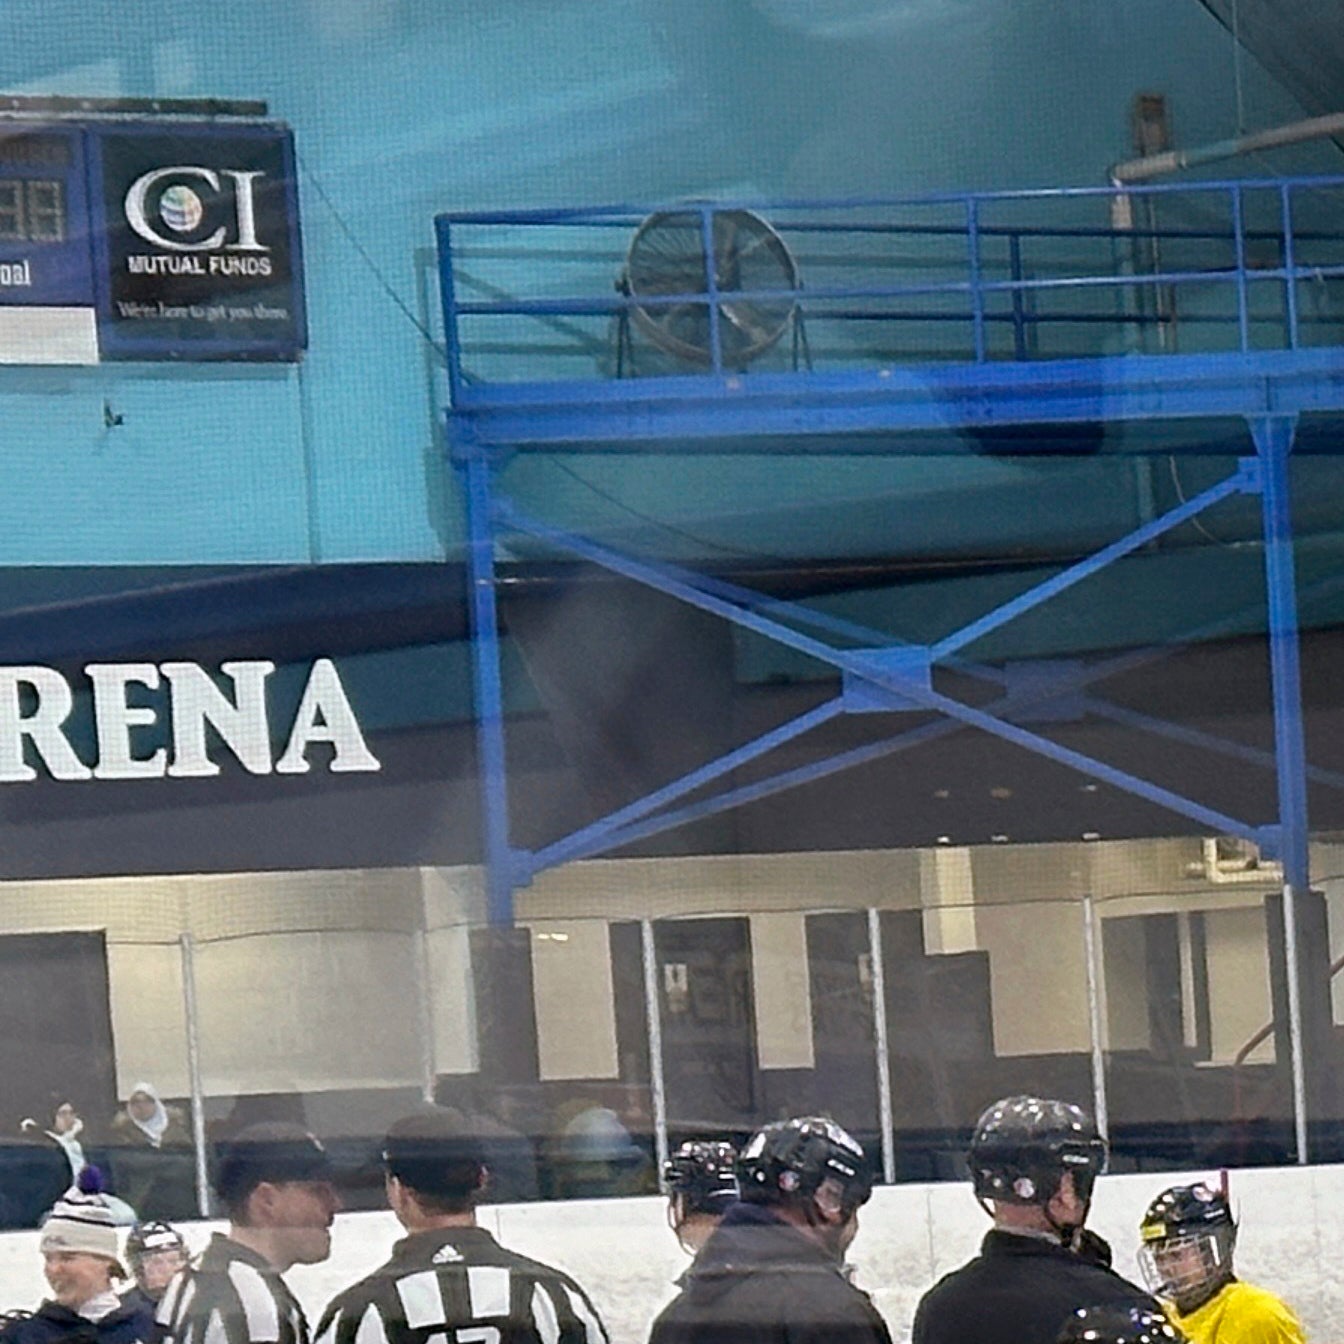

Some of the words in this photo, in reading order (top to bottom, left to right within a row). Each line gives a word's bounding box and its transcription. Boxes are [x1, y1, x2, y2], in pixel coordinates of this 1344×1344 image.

[125, 166, 270, 251] CI
[129, 255, 205, 275] MUTUAL
[209, 256, 272, 276] FUNDS
[0, 658, 382, 782] RENA
